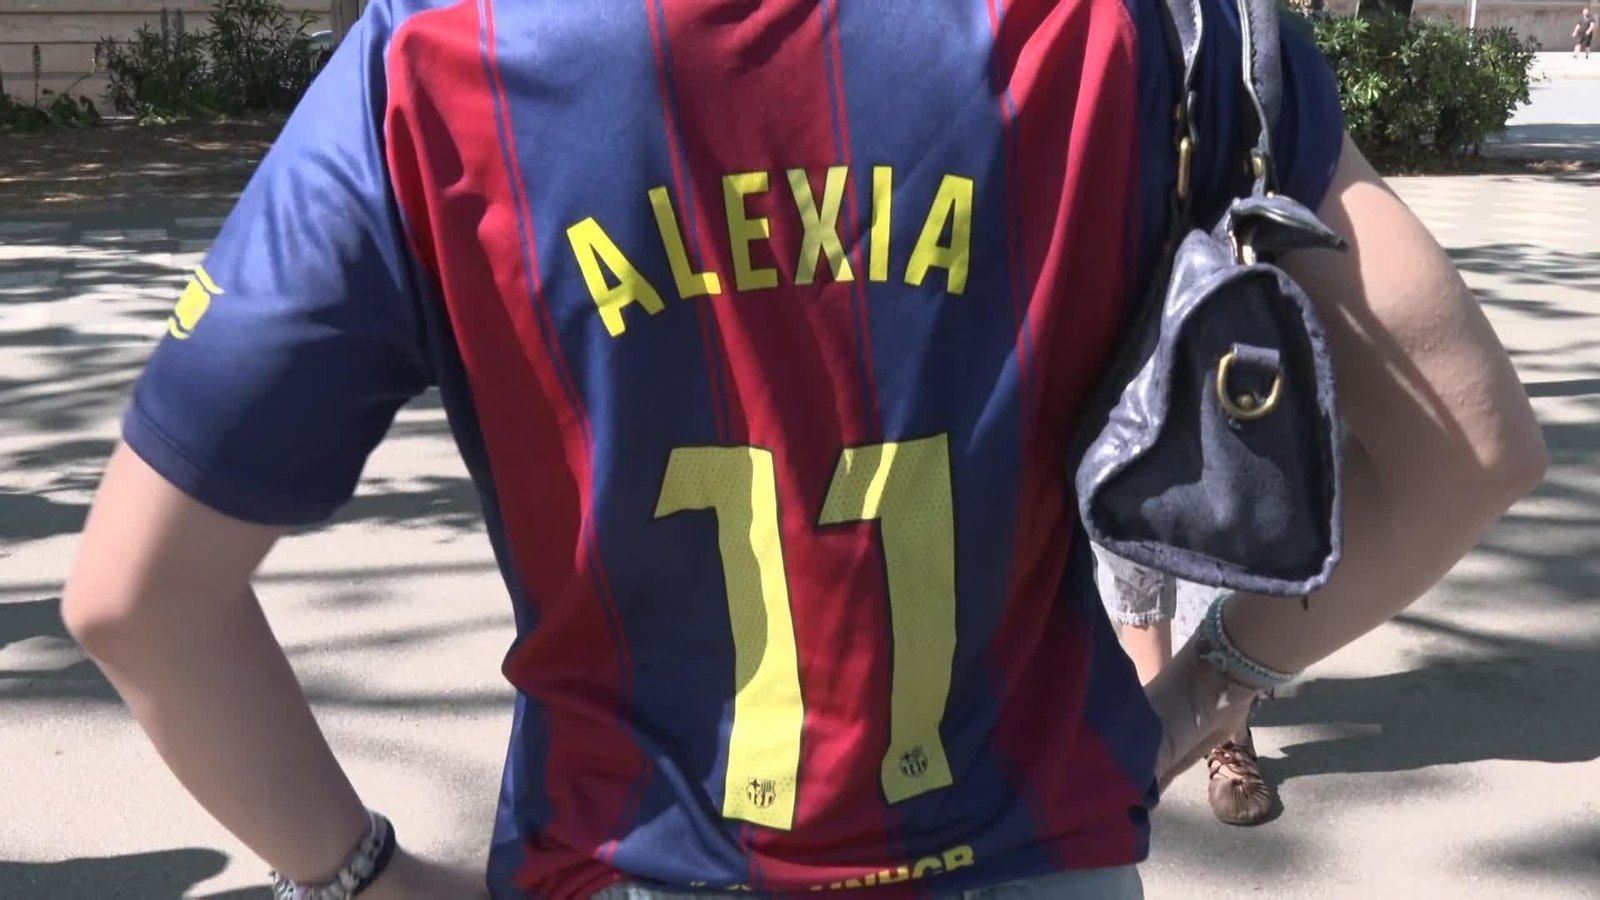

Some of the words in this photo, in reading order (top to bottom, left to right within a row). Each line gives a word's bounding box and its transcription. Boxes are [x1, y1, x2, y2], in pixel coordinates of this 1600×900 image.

[567, 166, 974, 337] ALEXIA
[654, 433, 957, 831] 11
[810, 844, 974, 891] HCR
